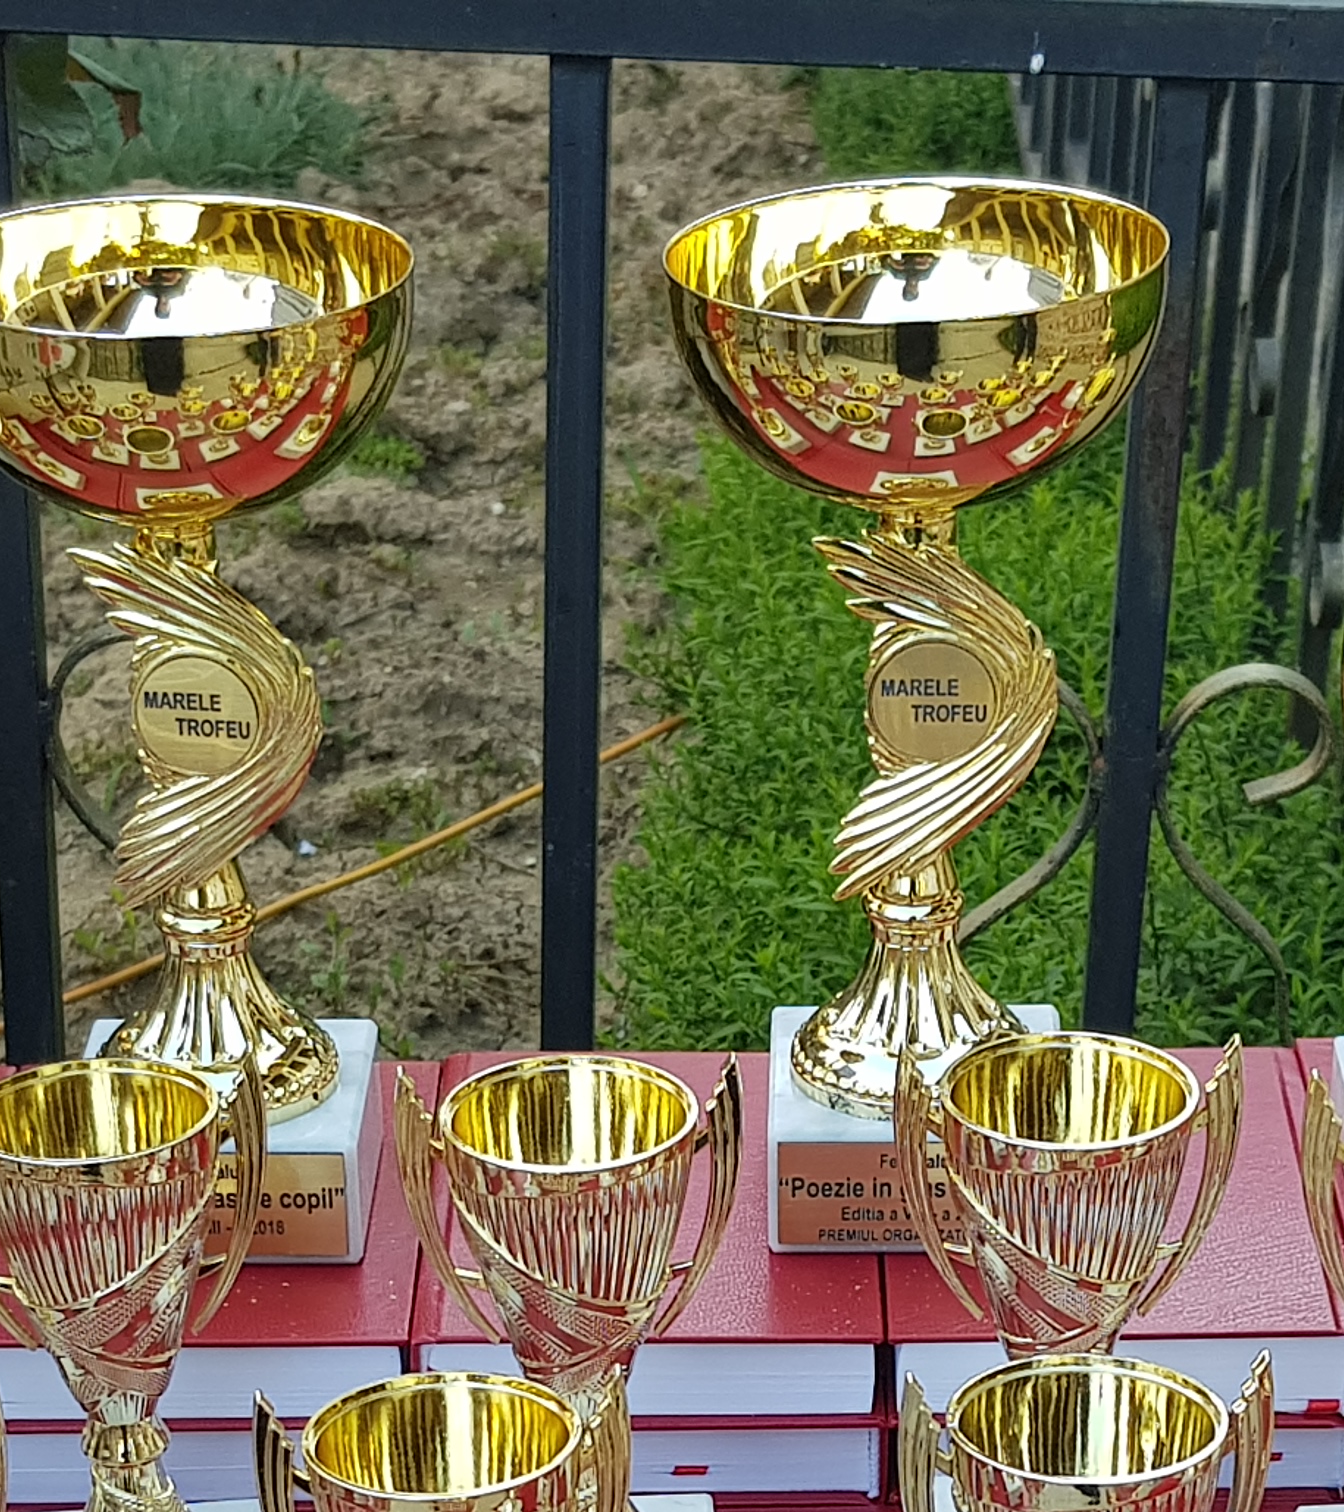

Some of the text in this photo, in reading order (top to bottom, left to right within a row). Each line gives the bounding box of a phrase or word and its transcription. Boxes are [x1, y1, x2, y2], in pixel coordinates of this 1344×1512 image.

[881, 678, 959, 697] MARELE
[143, 691, 222, 712] MARELE
[911, 704, 988, 723] TROFEU
[174, 717, 250, 739] TROFEU
[873, 1177, 892, 1198] in
[841, 1206, 885, 1221] Editia
[253, 1220, 285, 1236] 018
[818, 1228, 879, 1242] PREMIUL
